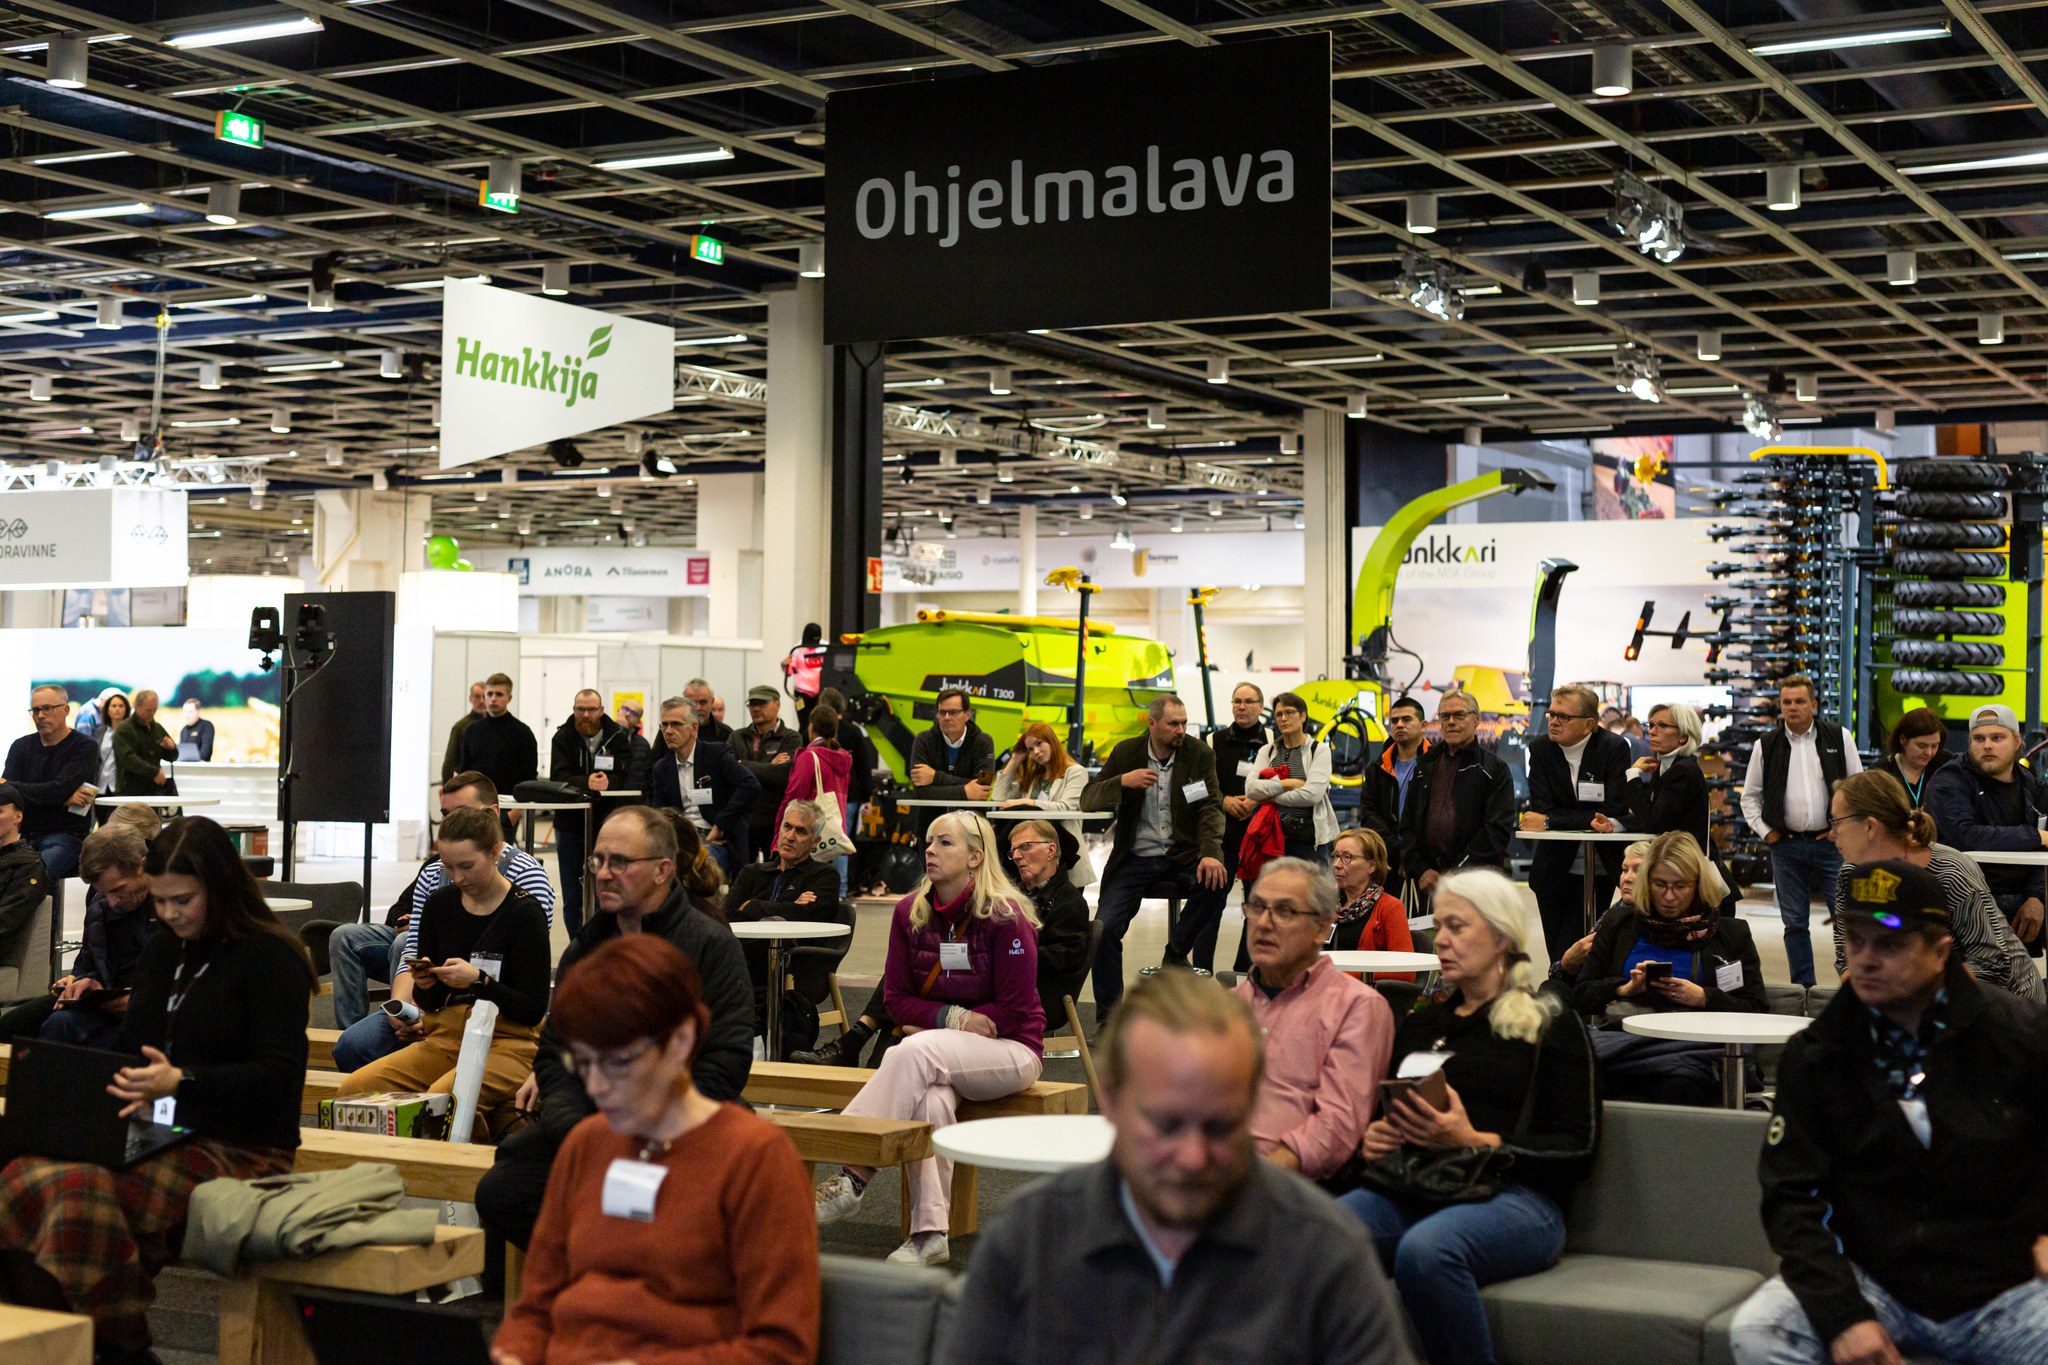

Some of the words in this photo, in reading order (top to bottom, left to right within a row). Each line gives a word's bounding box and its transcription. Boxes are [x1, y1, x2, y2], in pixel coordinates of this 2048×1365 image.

[855, 144, 1295, 248] Ohjelmalava
[456, 336, 599, 408] Hankkija
[993, 687, 1016, 700] T300
